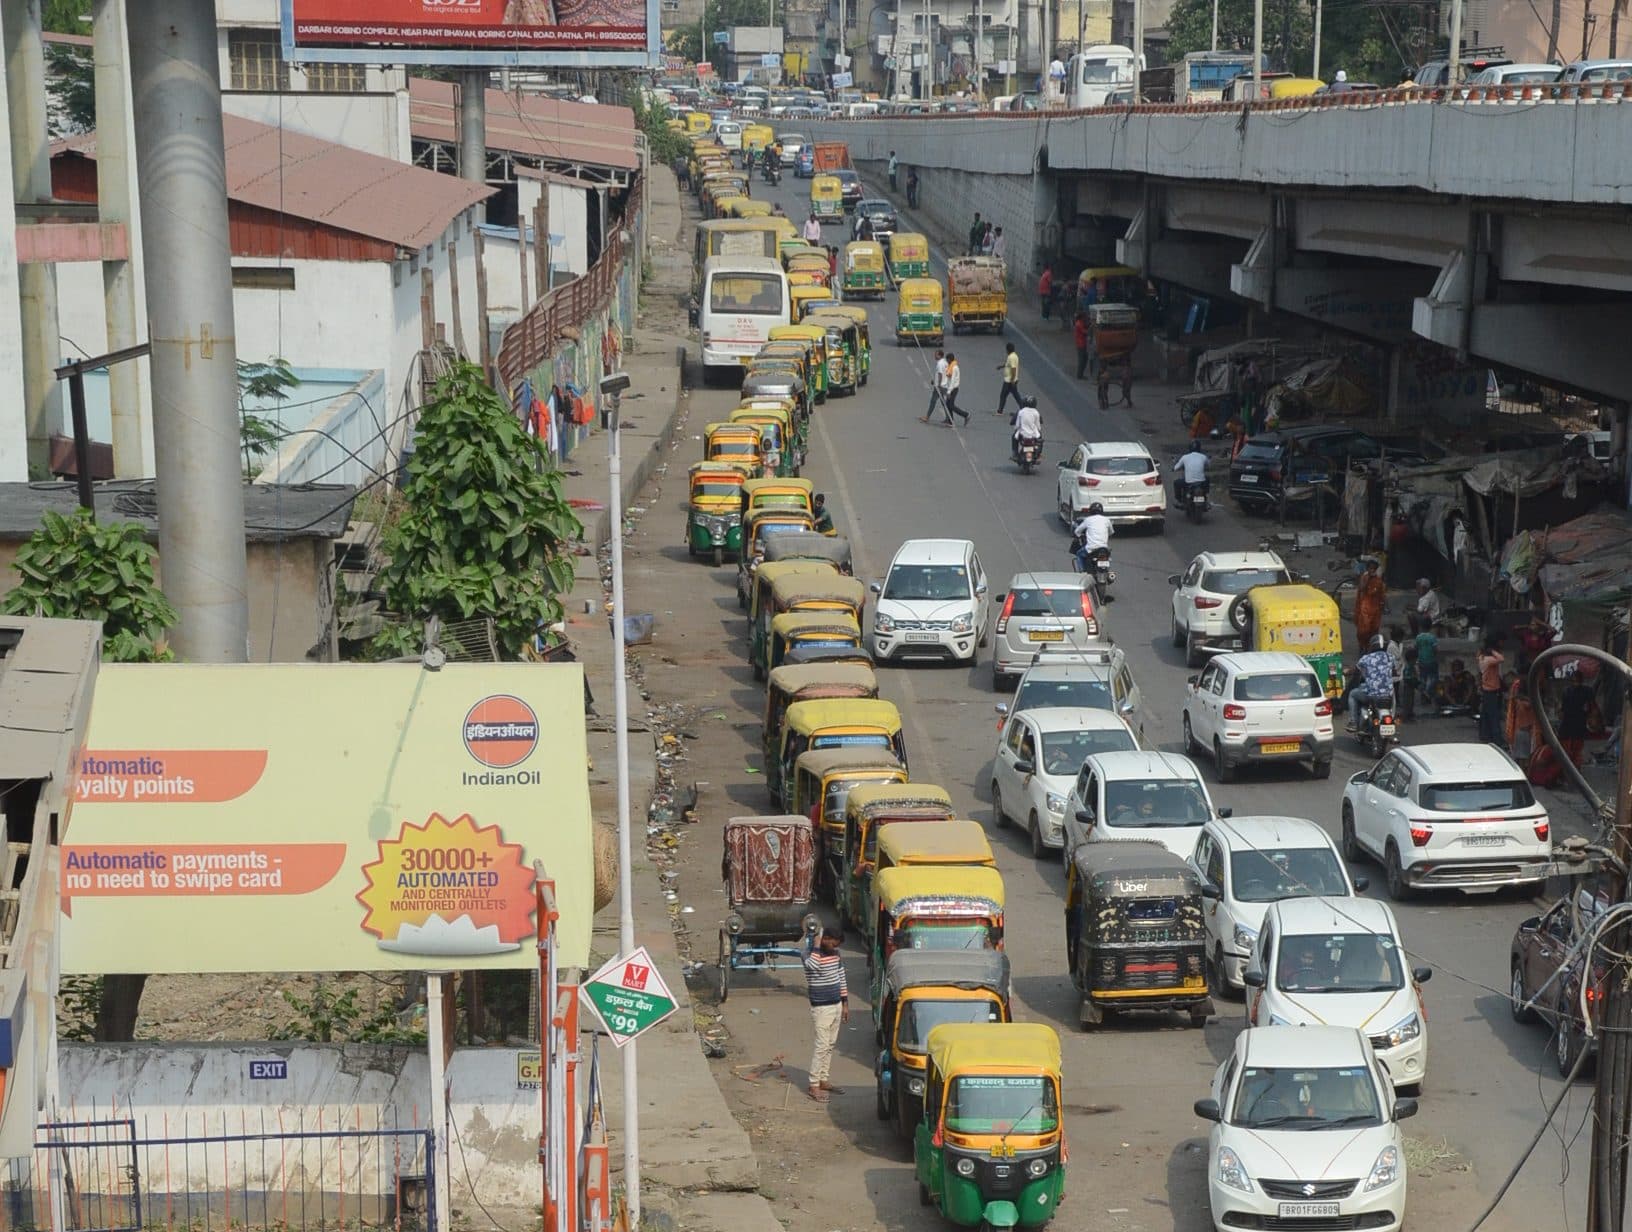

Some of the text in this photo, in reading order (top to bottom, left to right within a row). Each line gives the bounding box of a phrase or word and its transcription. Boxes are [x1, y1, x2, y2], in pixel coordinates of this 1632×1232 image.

[298, 25, 332, 34] DARBARI
[333, 26, 361, 35] GOBIND
[362, 27, 400, 36] COMPLEX,
[401, 28, 421, 36] NEAR
[423, 28, 443, 36] PANT
[444, 29, 477, 38] BHAVAN,
[478, 30, 506, 38] BORING
[507, 30, 533, 39] CANAL
[533, 31, 556, 40] ROAD,
[557, 31, 583, 40] PATNA,
[466, 723, 535, 740] इंडियनऑयल
[462, 770, 541, 786] IndianOil
[133, 776, 194, 798] points
[66, 850, 167, 870] Automatic
[172, 850, 268, 873] payments
[400, 847, 493, 871] 30000+
[66, 869, 282, 891] no need to swipe card
[397, 871, 499, 888] AUTOMATED
[1119, 882, 1148, 893] Uber
[402, 887, 491, 900] AND CENTRALLY
[390, 899, 507, 912] MONITORED OUTLETS
[631, 965, 644, 981] V
[623, 978, 645, 989] MART
[253, 1063, 284, 1077] EXIT
